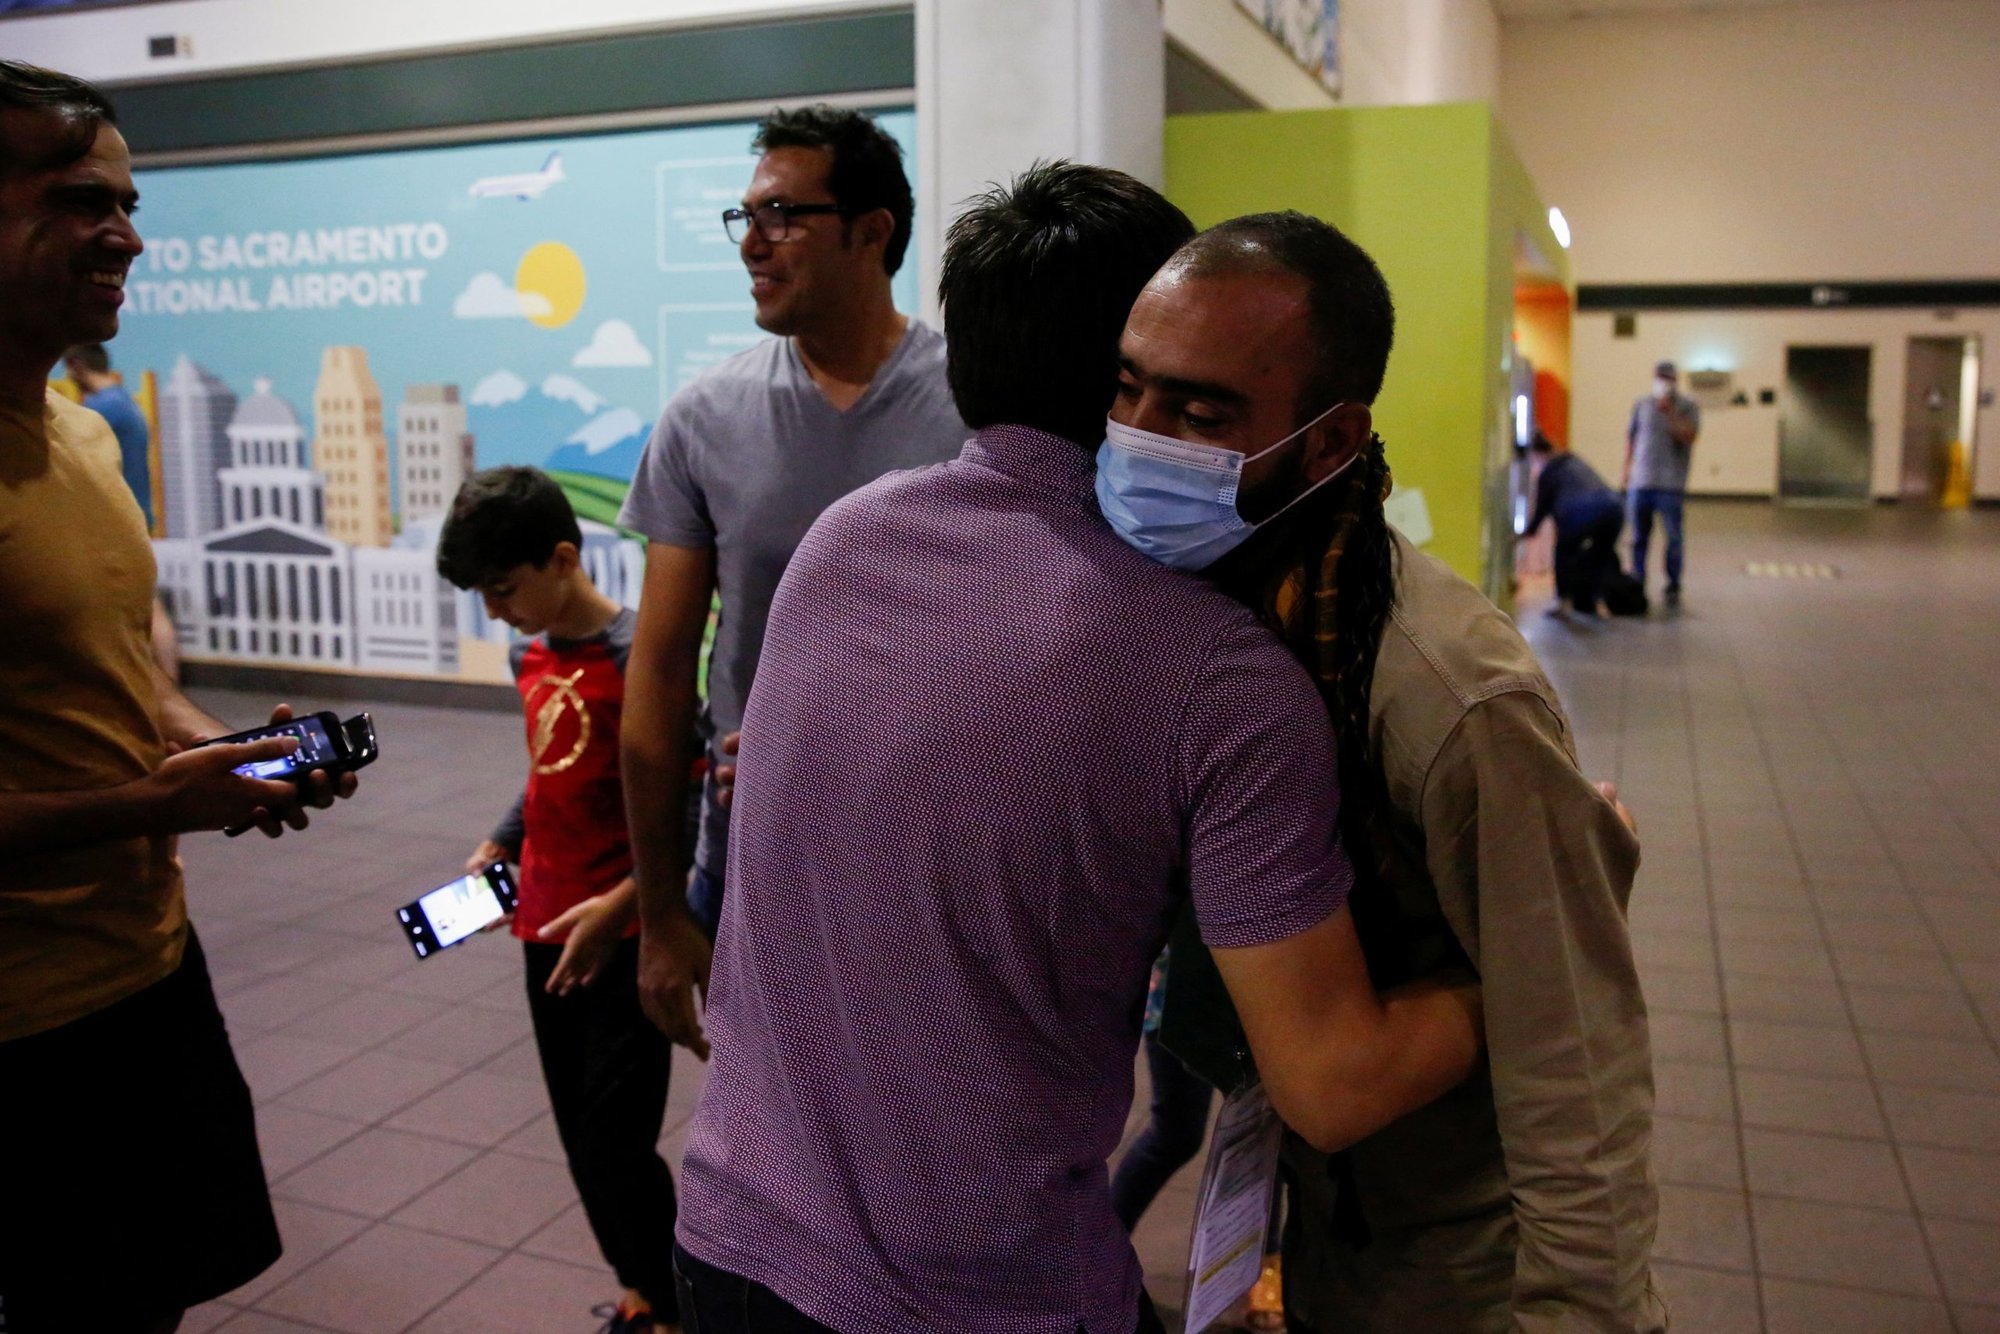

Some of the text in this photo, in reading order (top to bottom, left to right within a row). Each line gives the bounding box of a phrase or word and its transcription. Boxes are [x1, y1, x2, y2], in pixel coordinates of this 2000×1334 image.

[144, 222, 448, 272] TO SACRAMENTO
[267, 269, 427, 310] AIRPORT
